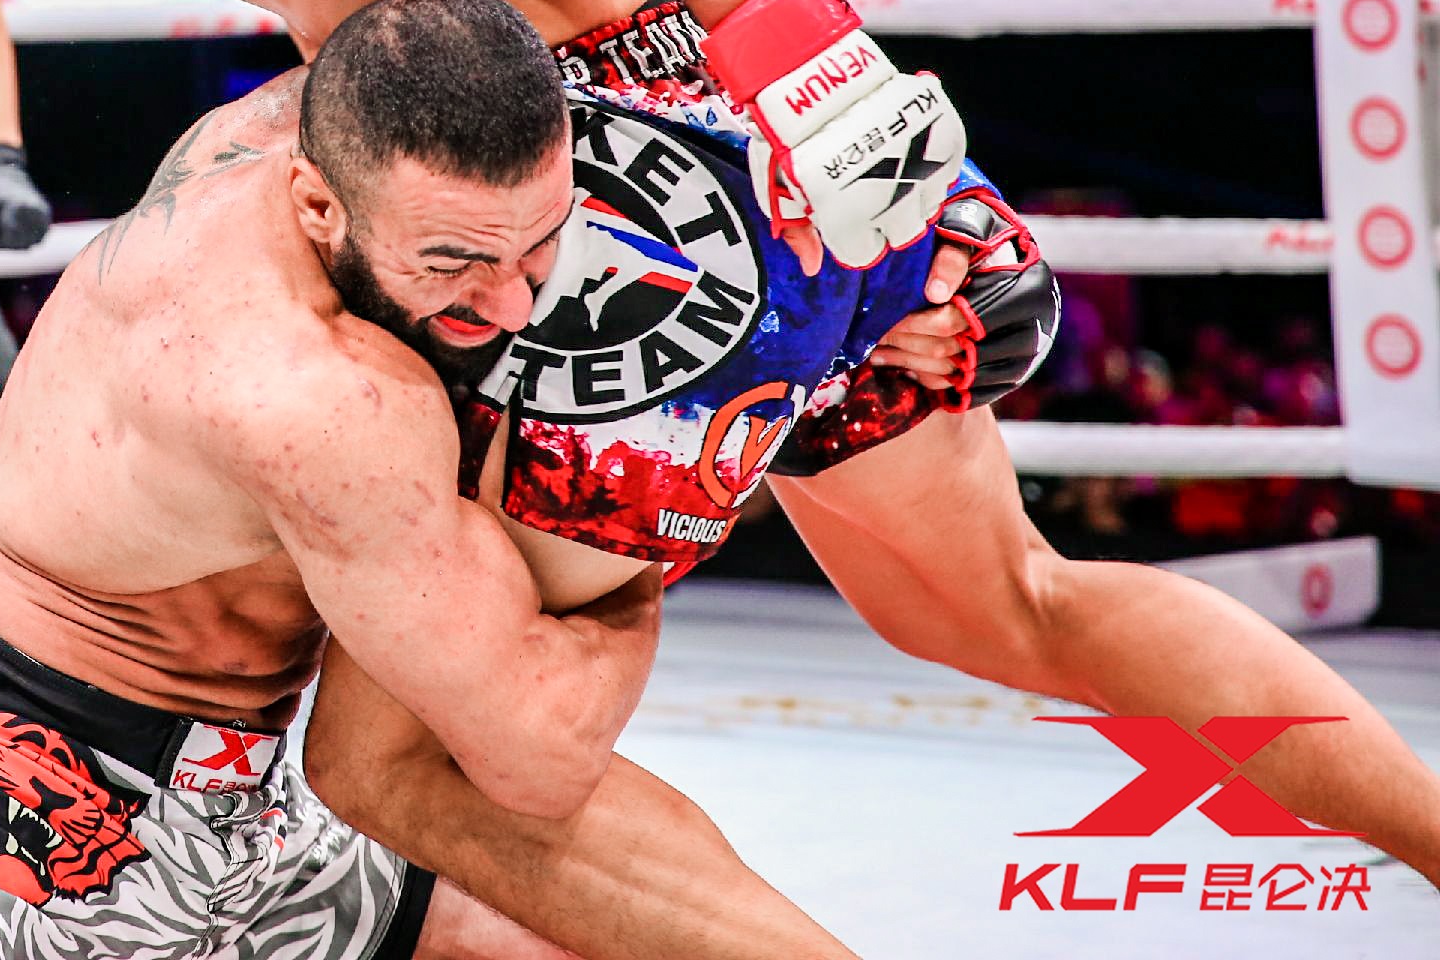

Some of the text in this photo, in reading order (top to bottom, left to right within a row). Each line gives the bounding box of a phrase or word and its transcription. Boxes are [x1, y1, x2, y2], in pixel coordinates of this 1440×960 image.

[785, 46, 878, 116] VENUM
[889, 88, 938, 138] KLF
[571, 108, 743, 247] KET
[510, 270, 756, 407] TEAM
[657, 508, 727, 543] VICIOUS
[172, 769, 222, 795] KLF
